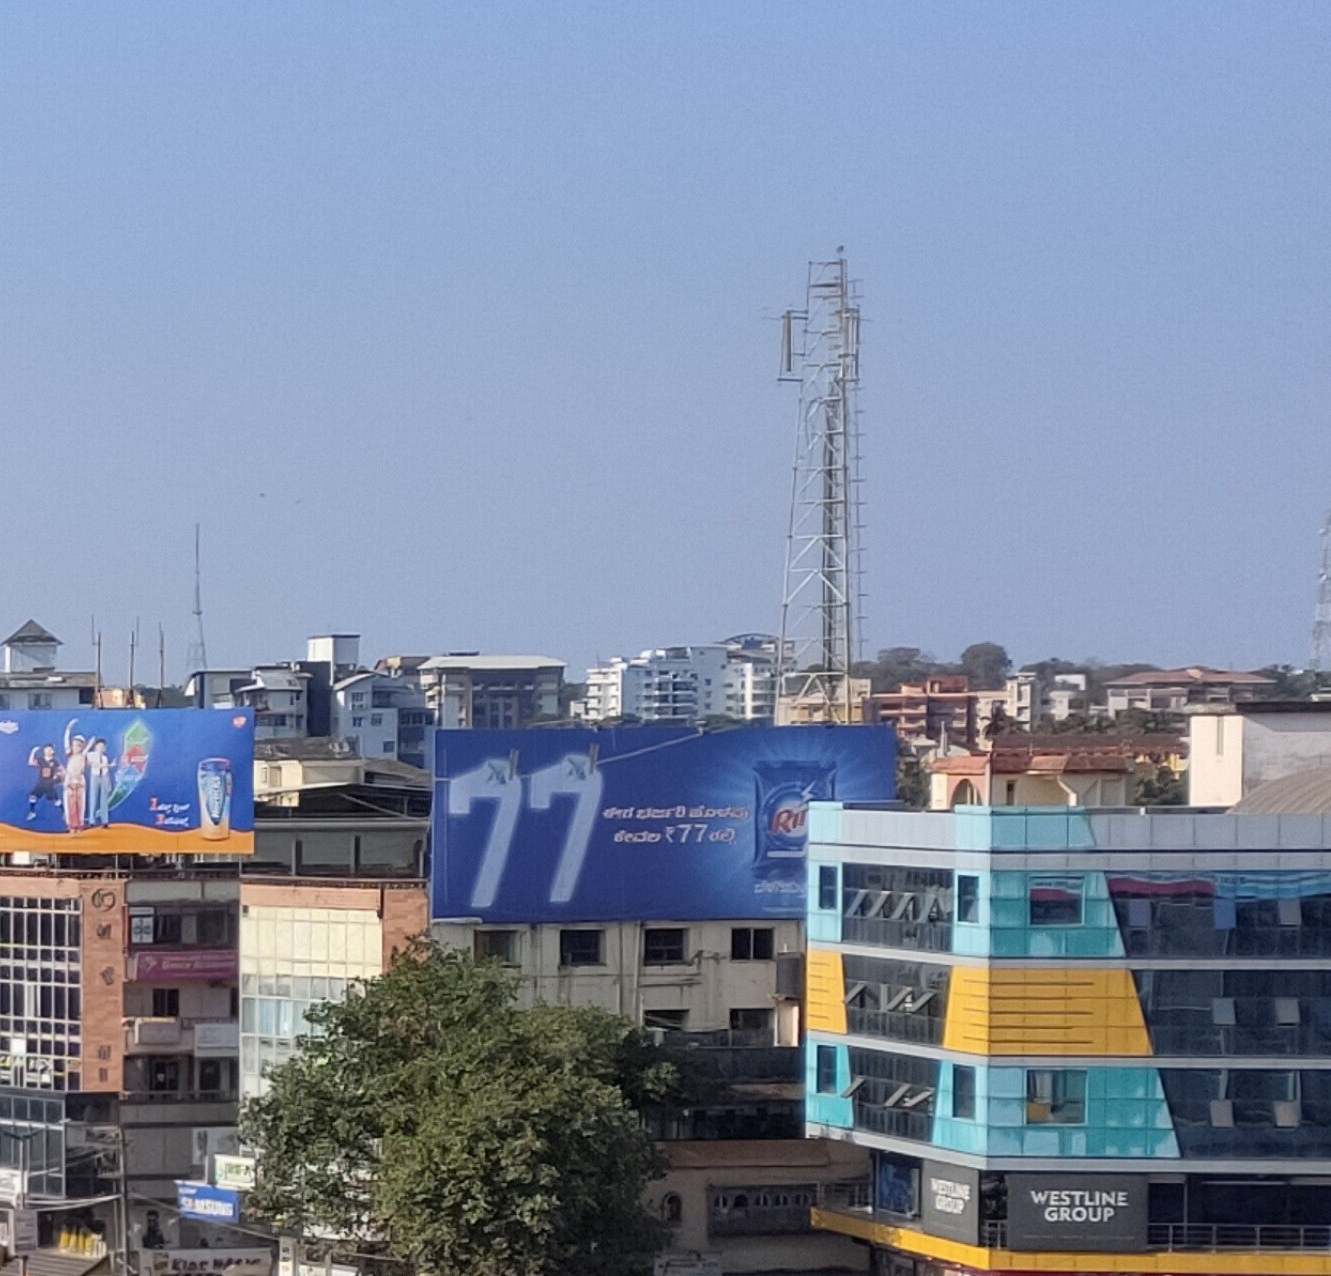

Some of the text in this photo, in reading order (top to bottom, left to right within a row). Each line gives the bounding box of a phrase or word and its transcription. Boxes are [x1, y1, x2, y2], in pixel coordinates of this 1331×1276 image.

[449, 754, 603, 907] 77
[930, 1178, 972, 1200] WESTLINE
[935, 1197, 965, 1214] GROUP
[1030, 1190, 1129, 1206] WESTLINE
[1044, 1207, 1115, 1222] GROUP
